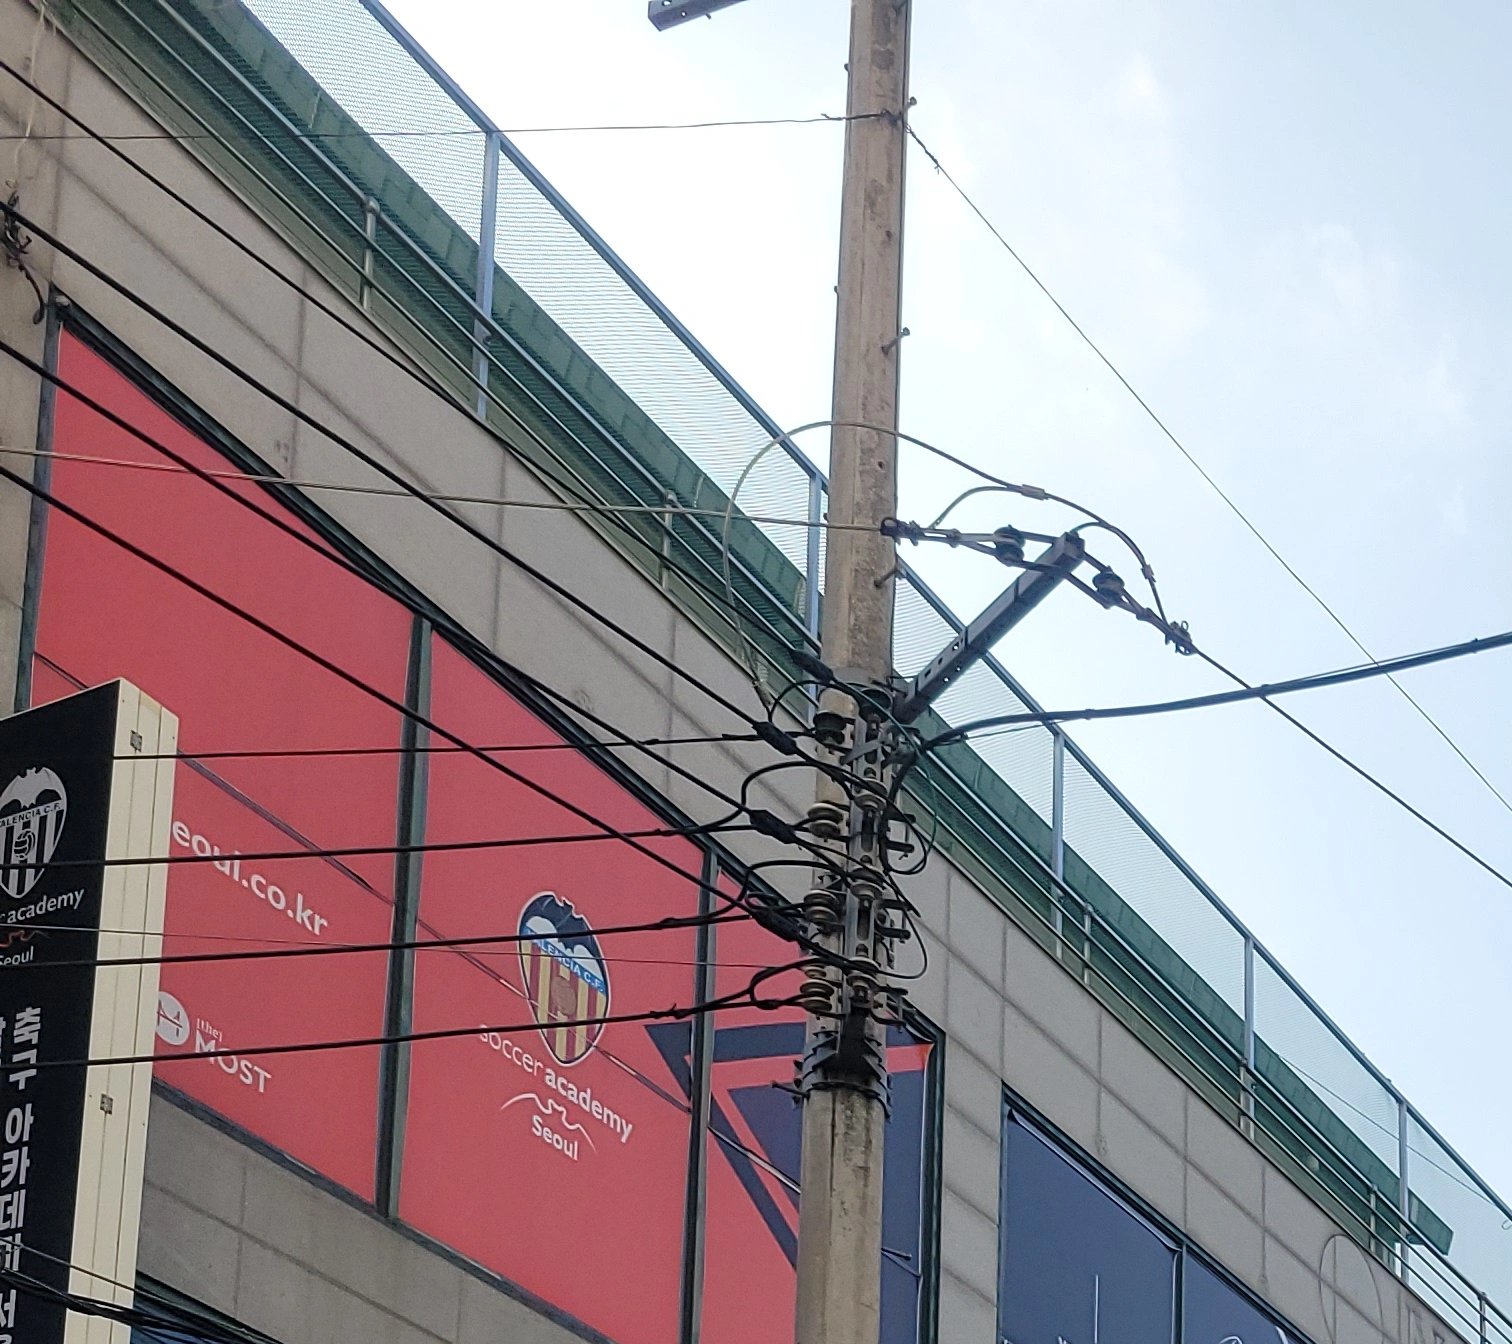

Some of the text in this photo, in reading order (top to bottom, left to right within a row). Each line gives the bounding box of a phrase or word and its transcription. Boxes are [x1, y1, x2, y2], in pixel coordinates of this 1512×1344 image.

[0, 808, 41, 828] ALENCIA
[7, 888, 85, 924] academy
[9, 1006, 42, 1091] 축구
[195, 1031, 273, 1093] MOST
[479, 1023, 633, 1144] soccer academy
[531, 1114, 580, 1161] Seoul
